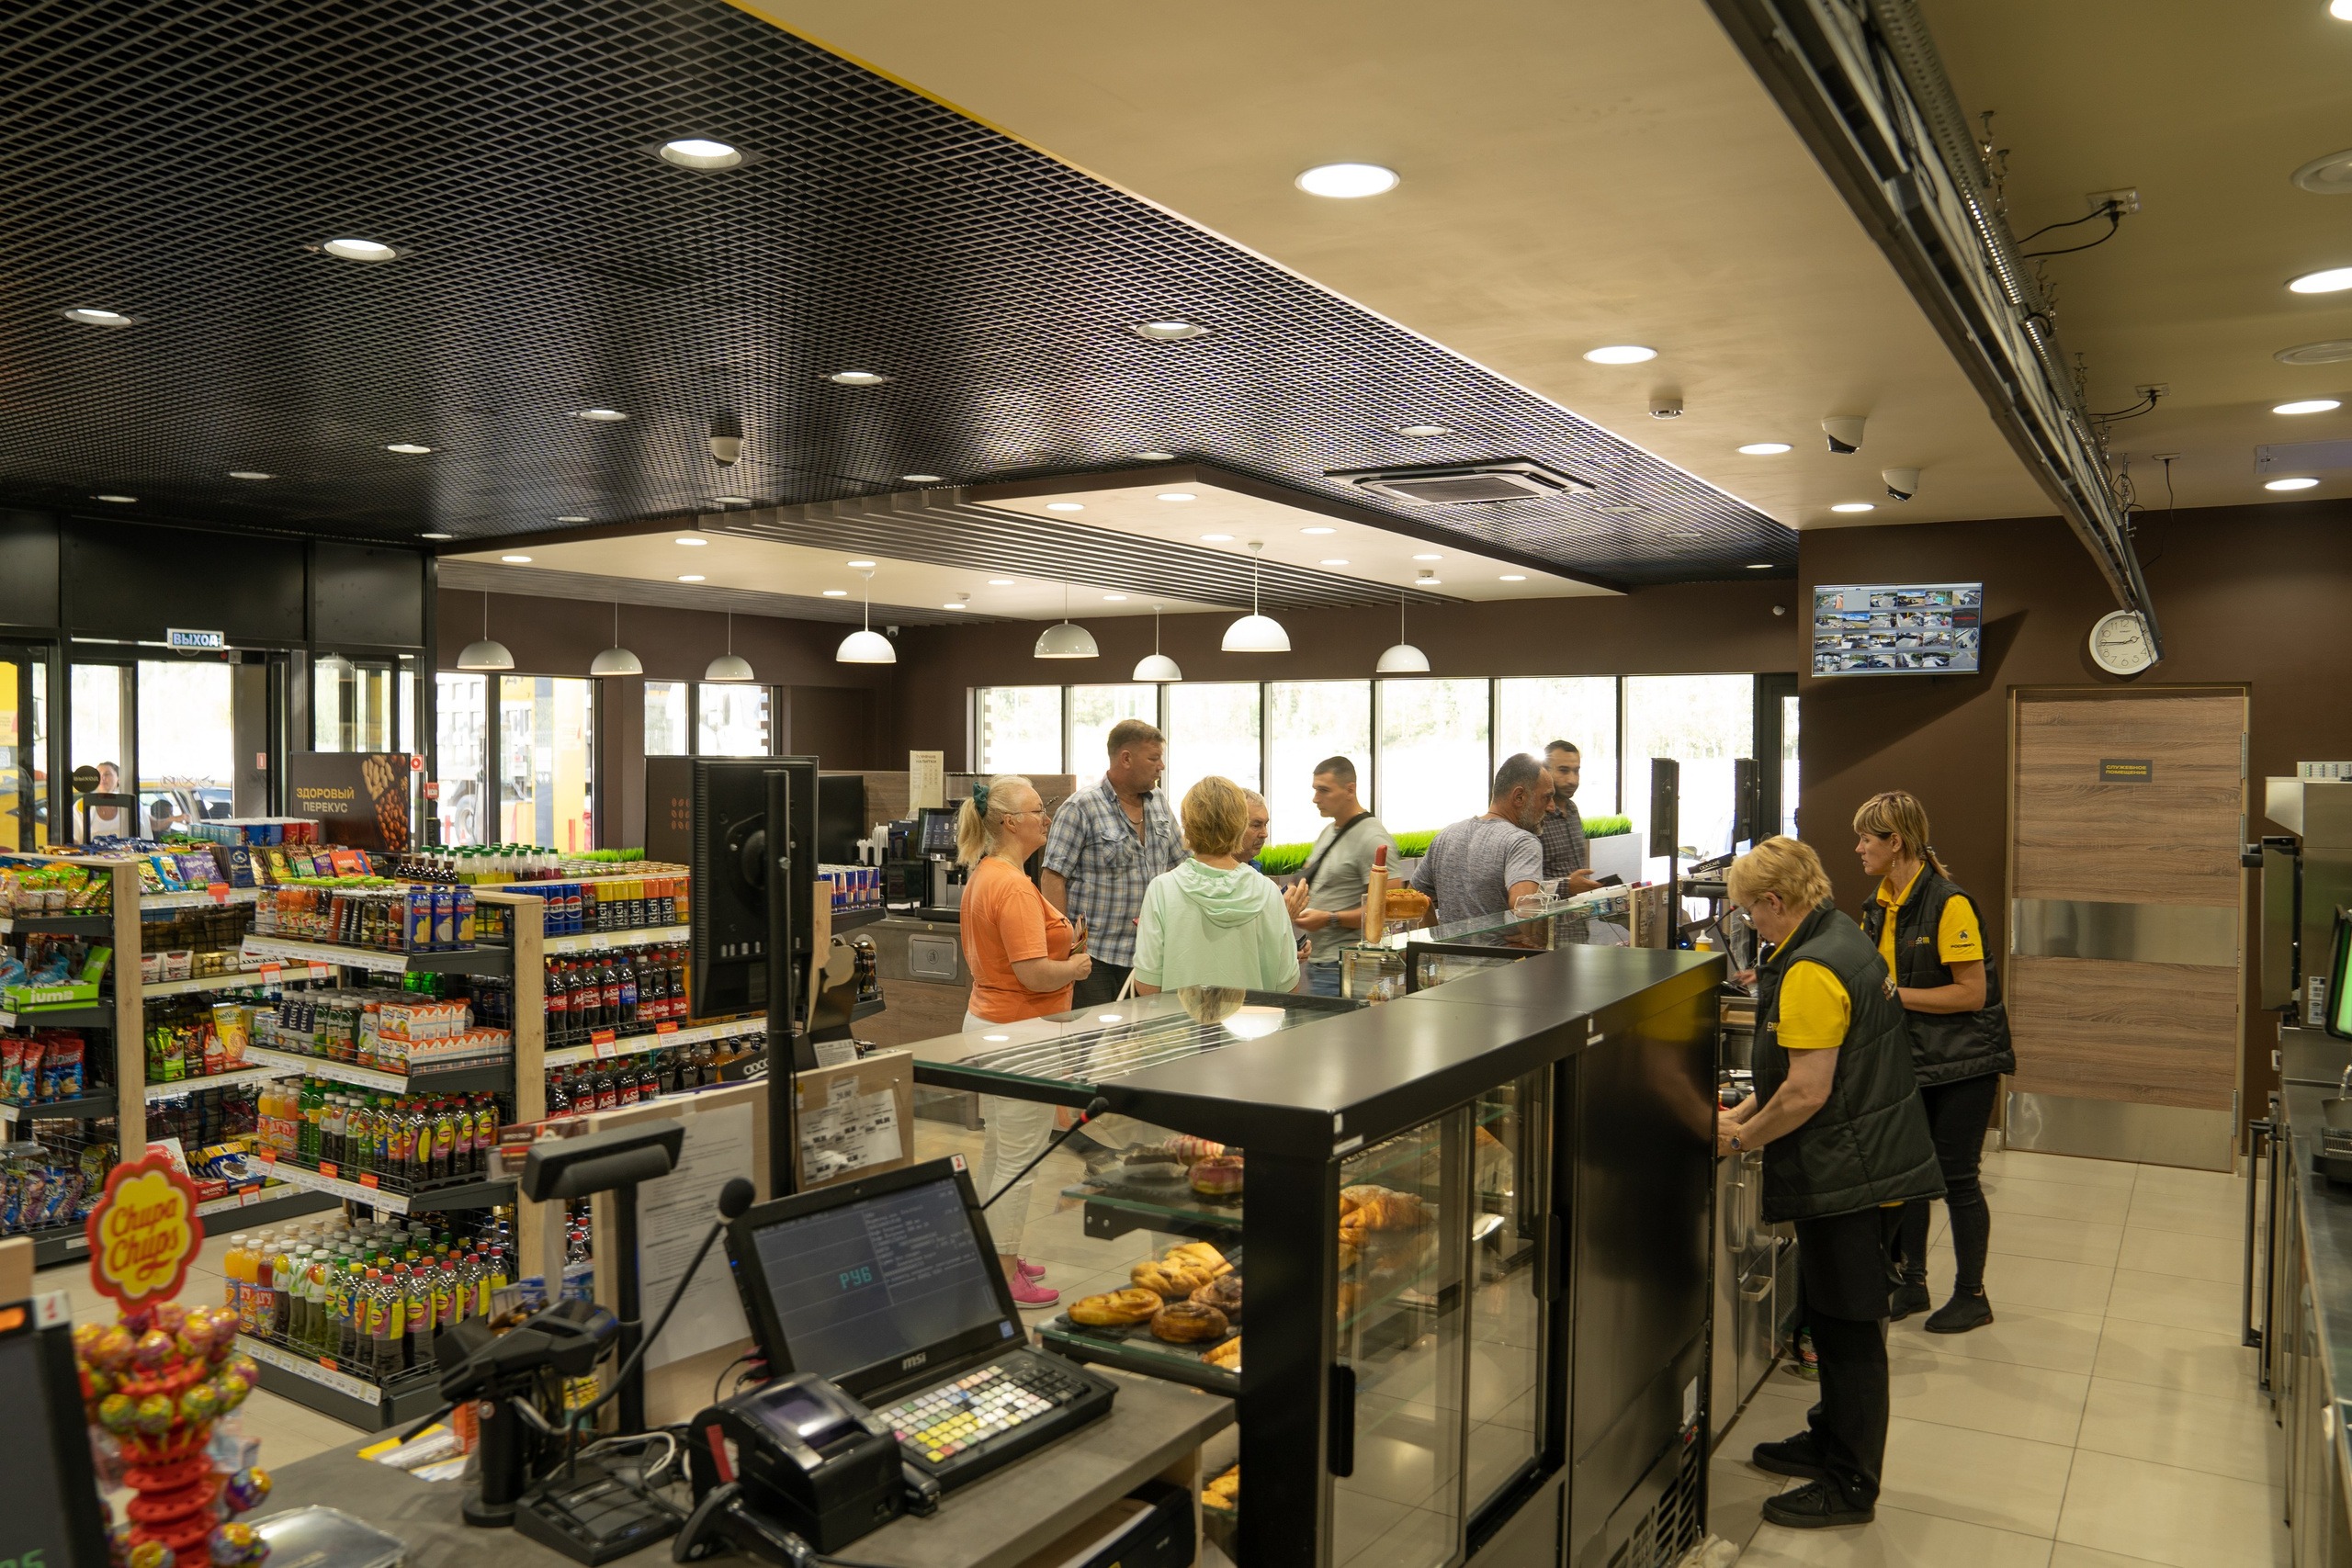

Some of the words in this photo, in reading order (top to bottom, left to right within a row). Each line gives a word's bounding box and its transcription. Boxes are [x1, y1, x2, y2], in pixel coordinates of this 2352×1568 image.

[173, 633, 219, 647] ВЫХОД
[296, 786, 355, 800] ЗДОРОВЫЙ
[302, 801, 348, 813] ПЕРЕКУС
[614, 901, 623, 925] Rich
[630, 900, 639, 924] Rich
[649, 899, 658, 923] Rich
[111, 1197, 178, 1237] Chupa
[110, 1225, 179, 1273] Chups
[902, 1352, 927, 1371] msi
